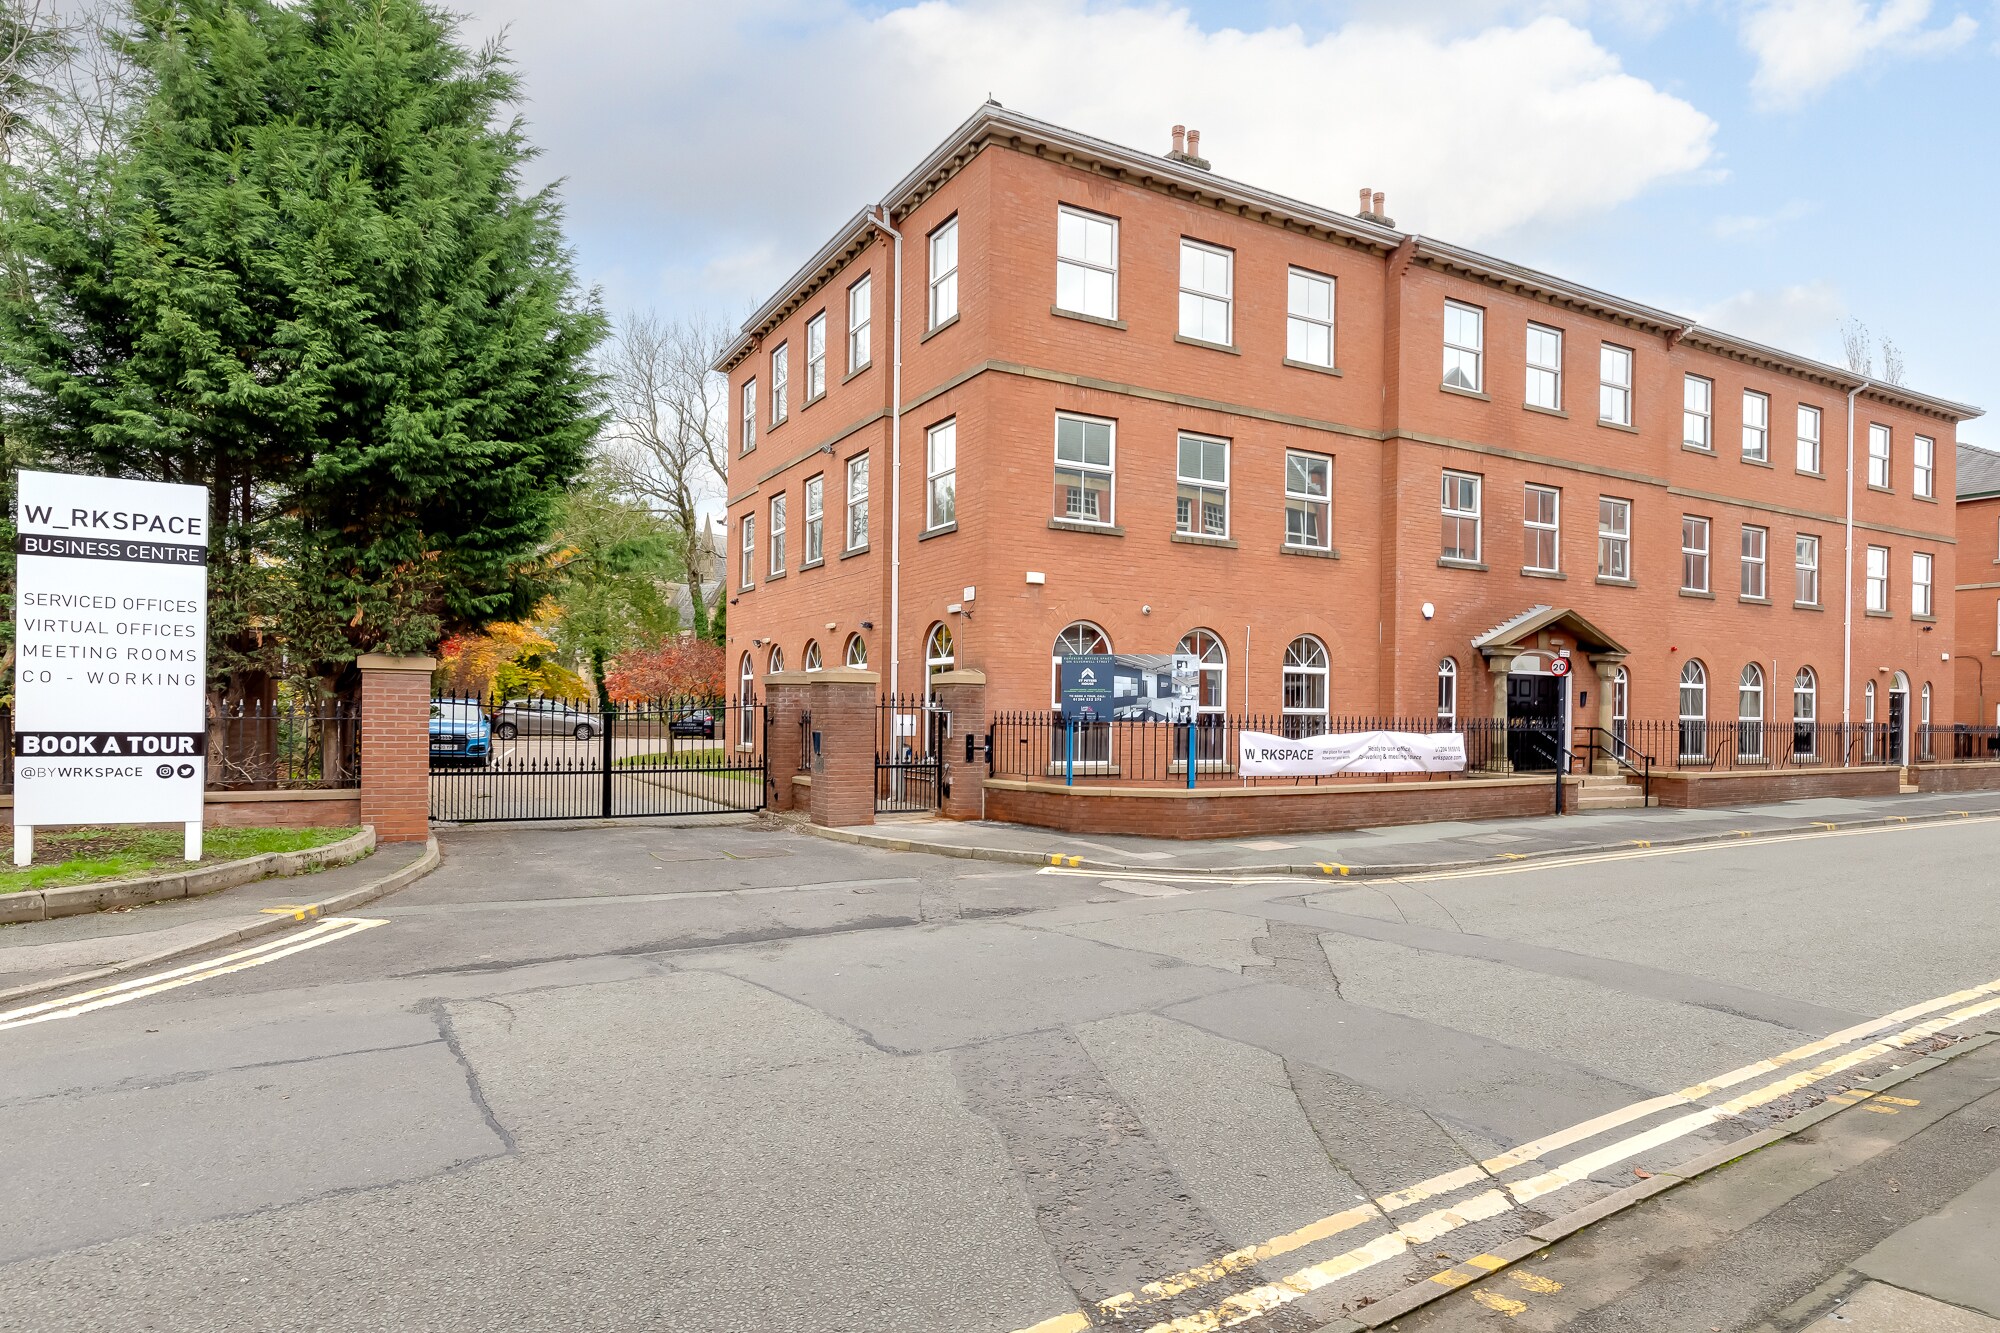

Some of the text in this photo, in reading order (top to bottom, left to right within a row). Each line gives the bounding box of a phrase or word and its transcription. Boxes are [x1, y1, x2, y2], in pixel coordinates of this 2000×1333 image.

[25, 504, 202, 536] W_RKSPACE
[25, 537, 200, 562] BUSINESS CENTRE
[23, 592, 198, 613] SERVICED OFFICES
[23, 618, 196, 638] VIRTUAL OFFICES
[22, 644, 197, 662] MEETING ROOMS
[86, 671, 197, 687] WORKING
[22, 735, 195, 754] BOOK A TOUR
[1245, 749, 1314, 762] W_RKSPACE
[20, 766, 143, 780] @BYWRKSPACE
